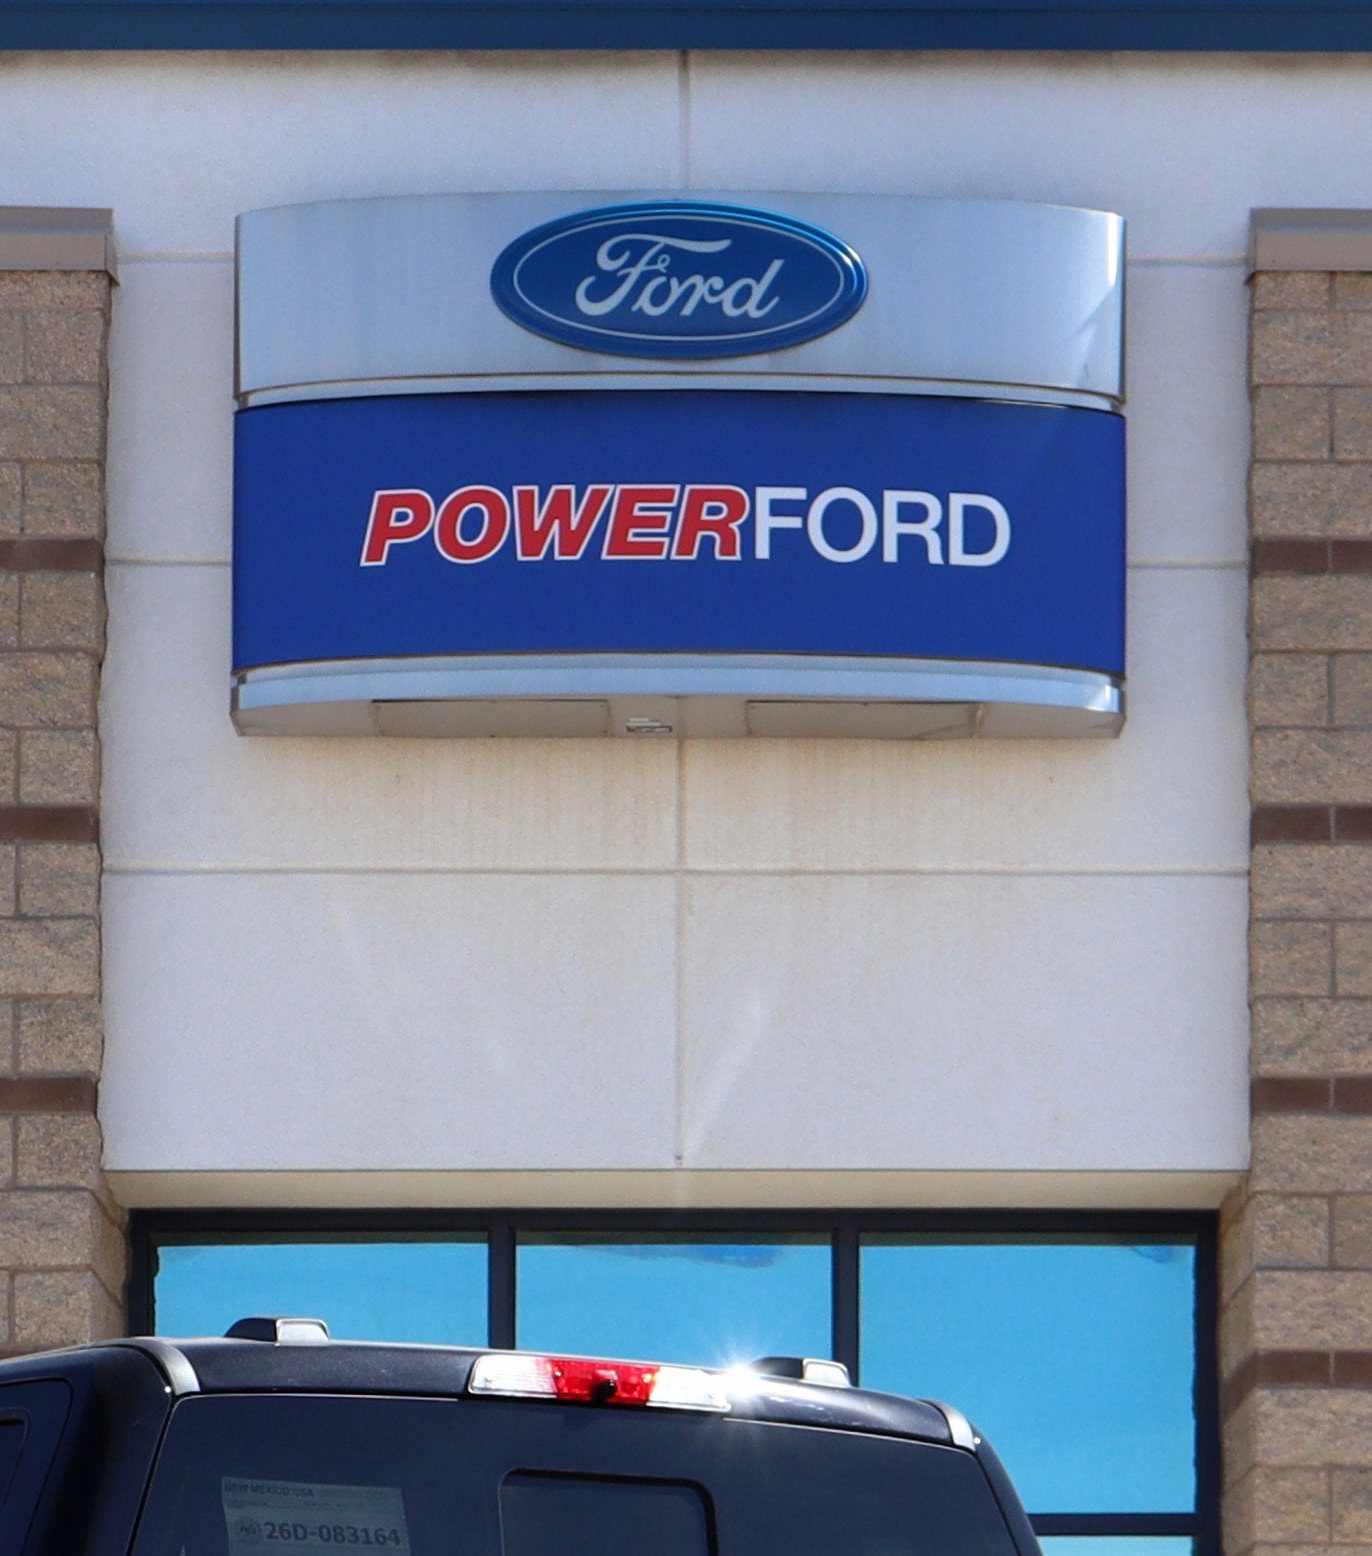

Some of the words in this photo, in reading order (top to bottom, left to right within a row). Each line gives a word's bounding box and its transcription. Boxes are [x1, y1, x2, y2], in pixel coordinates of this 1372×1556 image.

[575, 232, 784, 319] Ford
[249, 1485, 289, 1497] MEXICO
[293, 1488, 314, 1498] USA
[264, 1521, 401, 1546] 26D-083164
